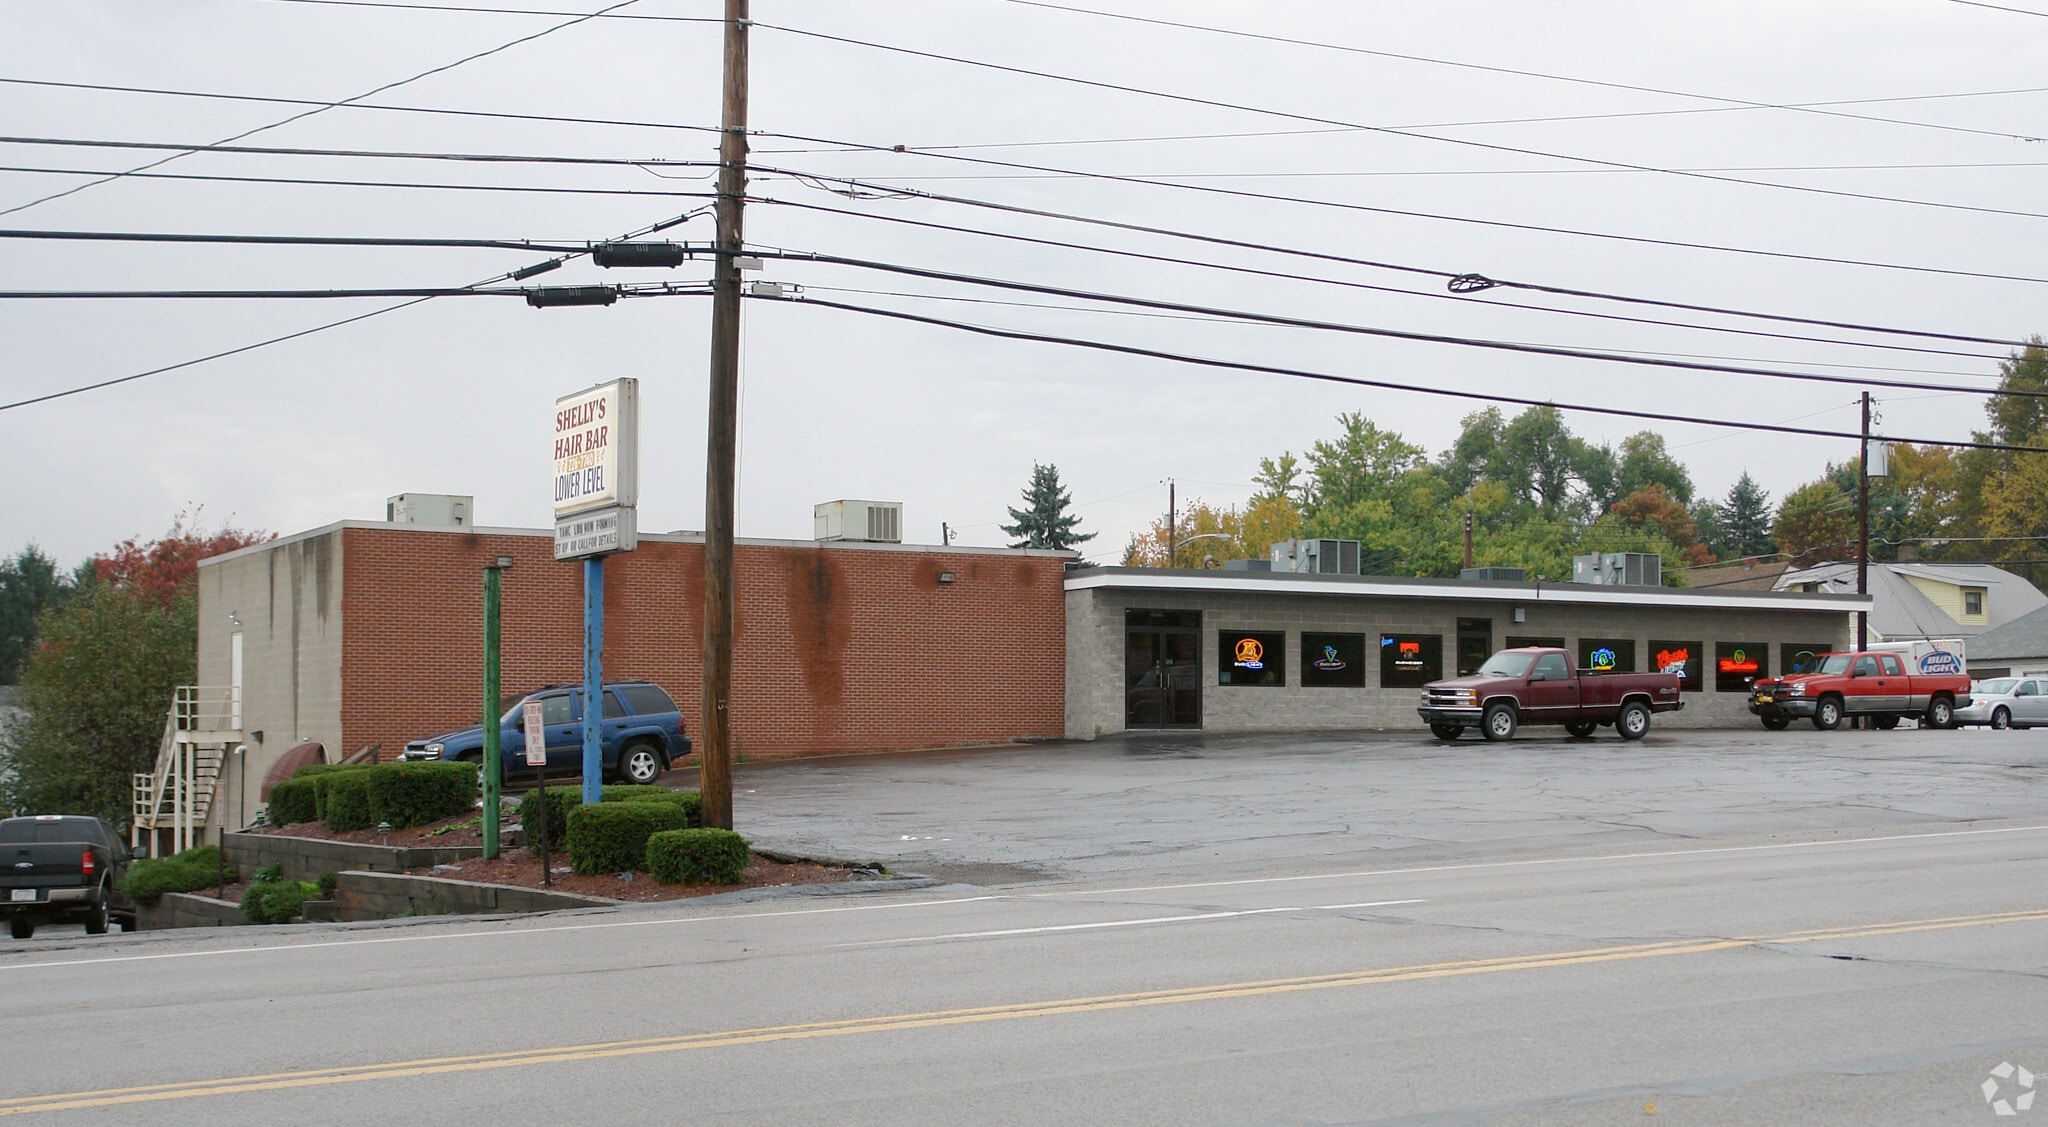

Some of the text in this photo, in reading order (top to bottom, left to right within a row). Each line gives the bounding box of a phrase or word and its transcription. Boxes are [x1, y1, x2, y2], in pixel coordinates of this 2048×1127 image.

[556, 397, 606, 433] SHELLY'S
[554, 425, 608, 461] HAIR BAR
[554, 464, 605, 502] LOWER LEVEL
[598, 532, 617, 546] DETAILS
[1924, 664, 1956, 673] LIGHT
[1927, 656, 1952, 664] BUD
